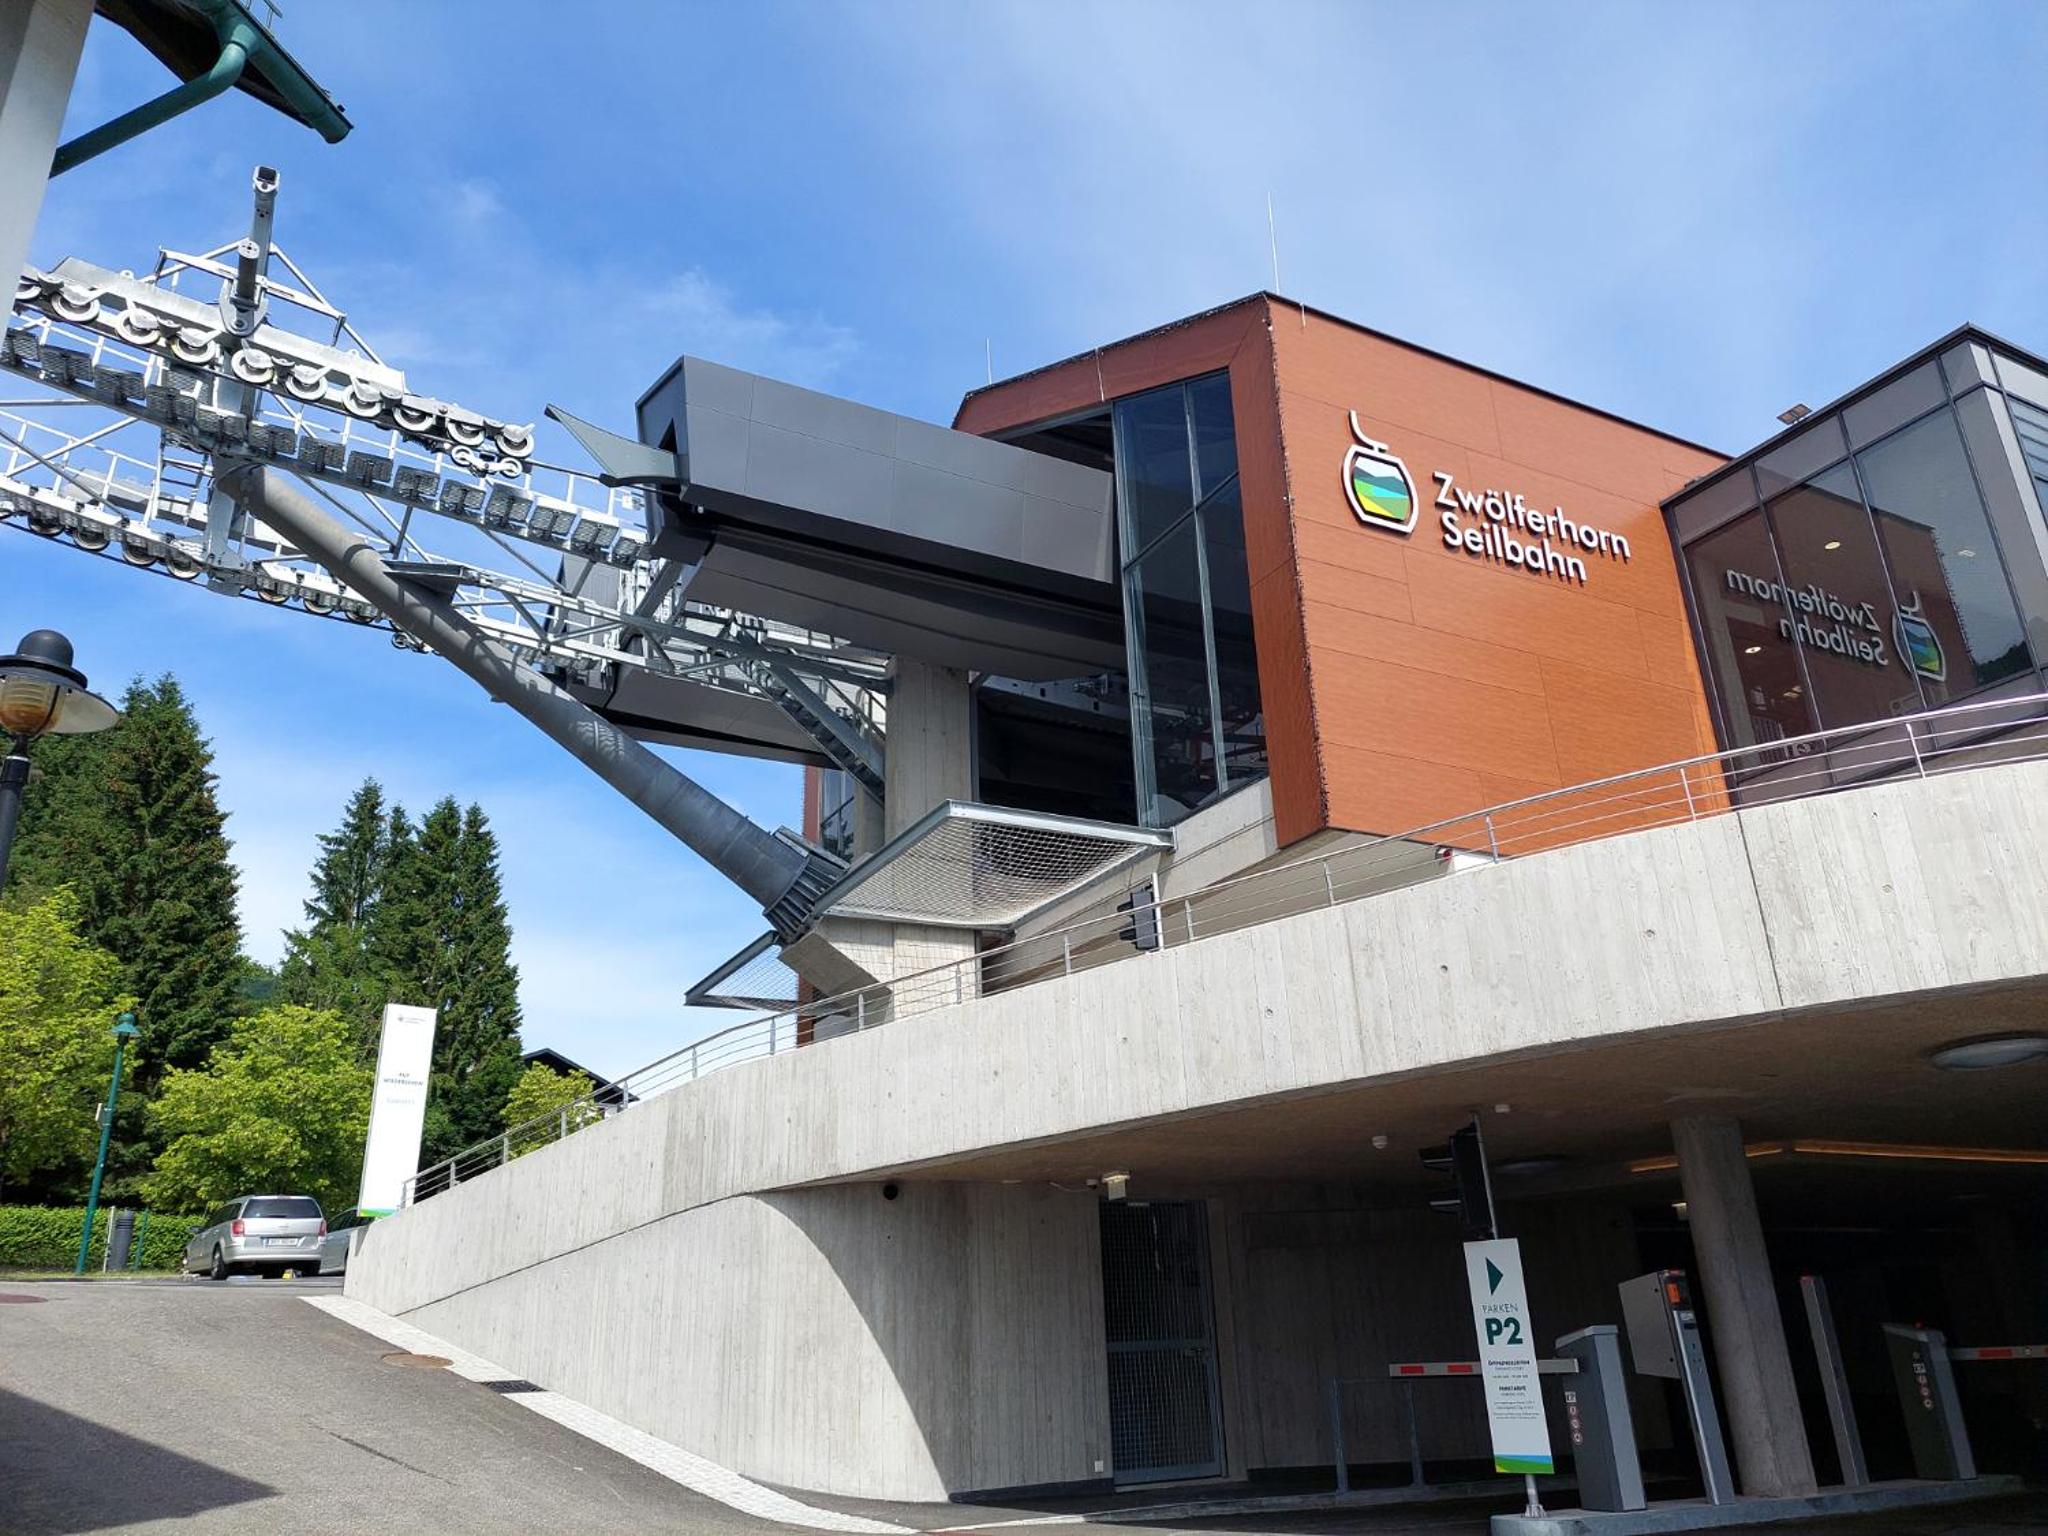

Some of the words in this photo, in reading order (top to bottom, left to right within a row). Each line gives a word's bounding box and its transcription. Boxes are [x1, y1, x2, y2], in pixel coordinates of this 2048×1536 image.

[1433, 471, 1632, 559] Zwölferhorn
[1441, 511, 1588, 582] Seilbahn
[1482, 1304, 1519, 1313] PARKEN
[1485, 1317, 1523, 1345] P2
